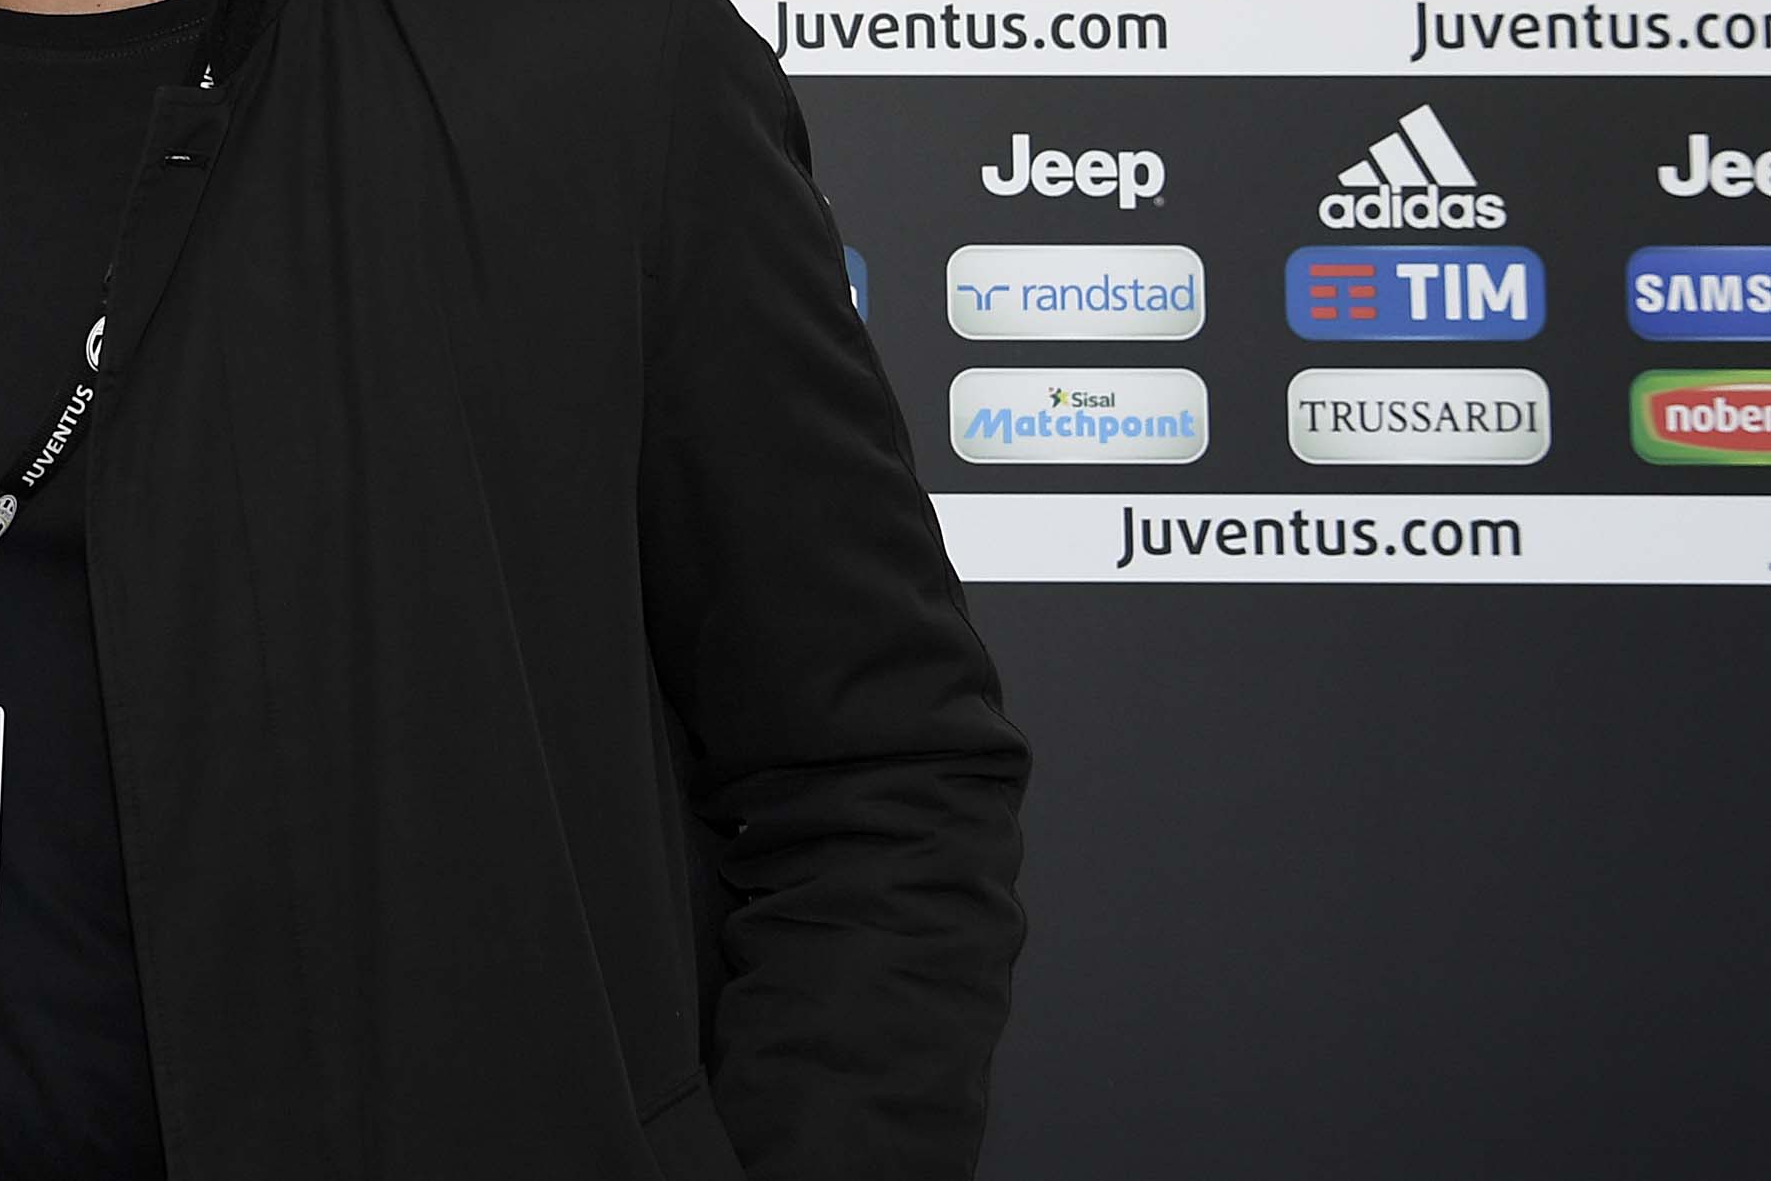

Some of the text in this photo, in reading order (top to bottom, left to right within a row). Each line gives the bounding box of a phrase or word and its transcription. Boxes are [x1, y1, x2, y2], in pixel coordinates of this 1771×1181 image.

[775, 1, 1168, 62] Juventus.com
[1411, 2, 1771, 62] Juventus.co
[981, 133, 1166, 209] Jeep
[1319, 185, 1507, 229] adidas
[1022, 274, 1196, 312] randstad
[1396, 263, 1528, 321] TIM
[1635, 273, 1771, 314] SAMS
[1071, 391, 1116, 408] Sisal
[1300, 400, 1537, 432] TRUSSARDI
[21, 384, 94, 487] JUVENTUS
[964, 408, 1196, 444] Matchpoint
[1116, 506, 1522, 570] Juventus.com
